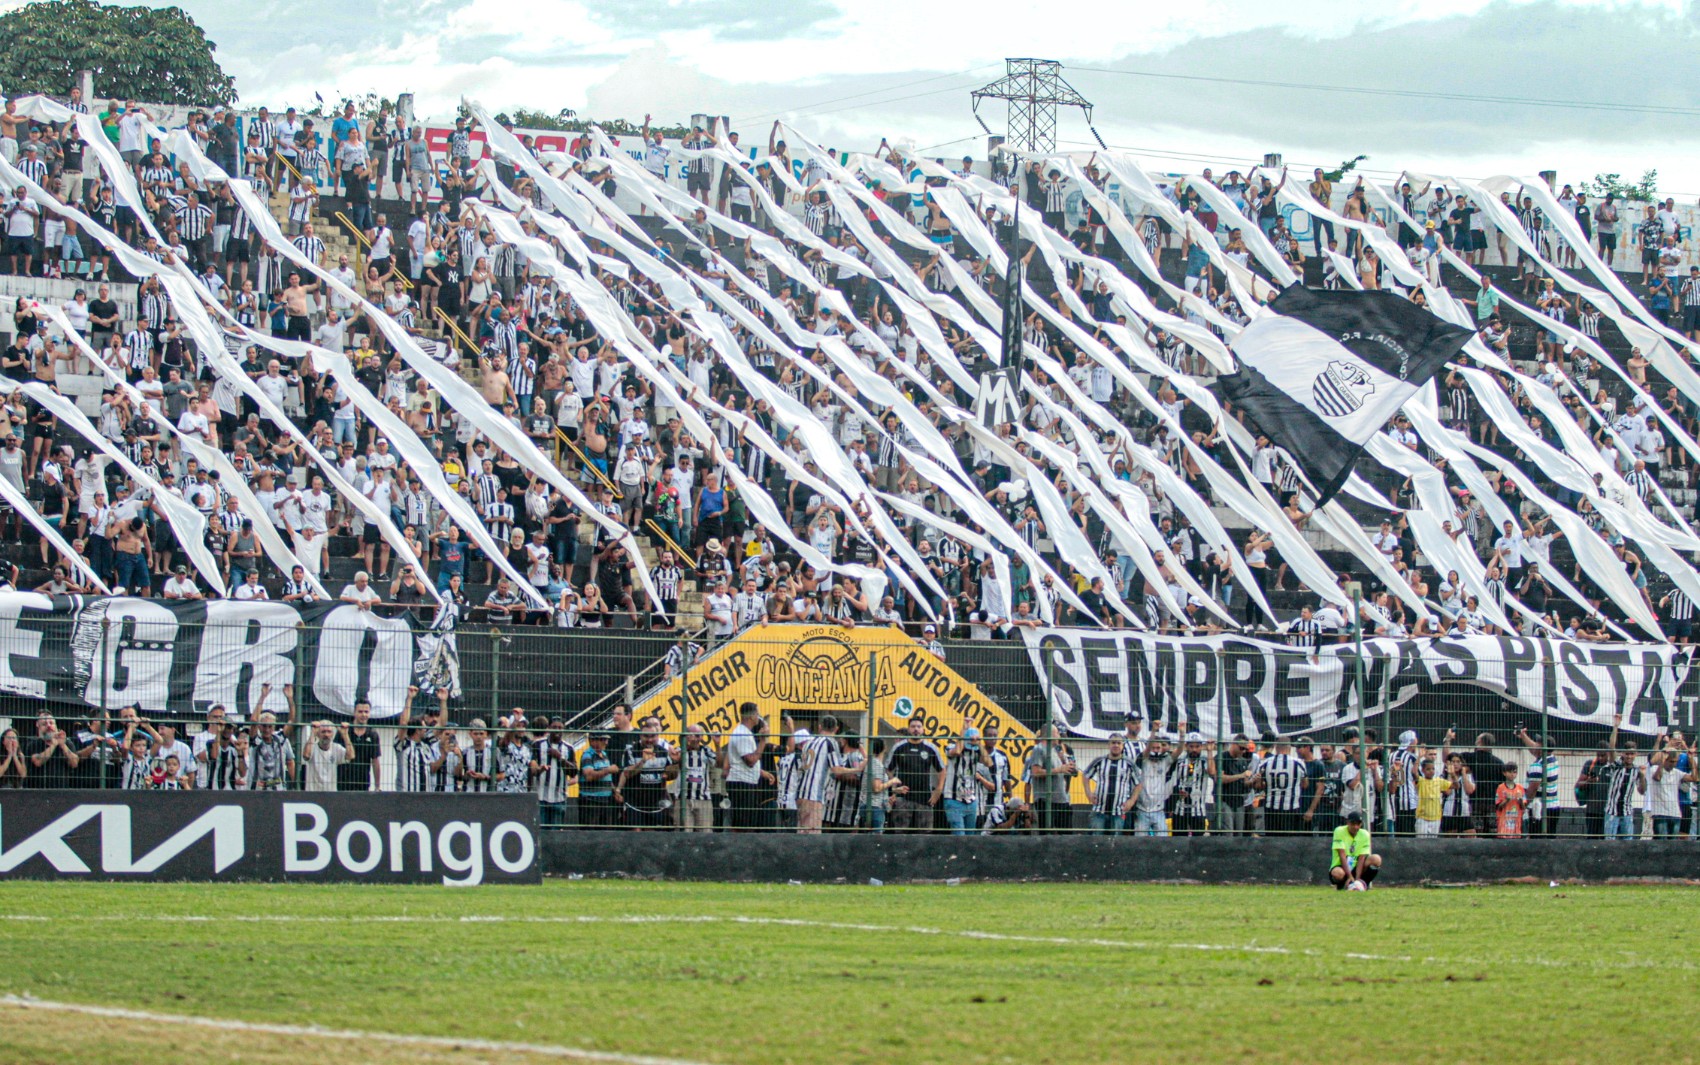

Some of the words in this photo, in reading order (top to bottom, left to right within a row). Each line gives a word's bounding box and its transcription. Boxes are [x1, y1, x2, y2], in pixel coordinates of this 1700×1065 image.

[802, 627, 825, 644] MOTO
[828, 628, 860, 654] ESCOLA
[667, 650, 752, 721] DIRIGIR
[756, 653, 897, 709] CONFIANÇA
[898, 650, 951, 698] AUTO
[1039, 633, 1312, 735] SEMPRE
[1269, 771, 1290, 790] 10
[282, 802, 536, 887] Bongo
